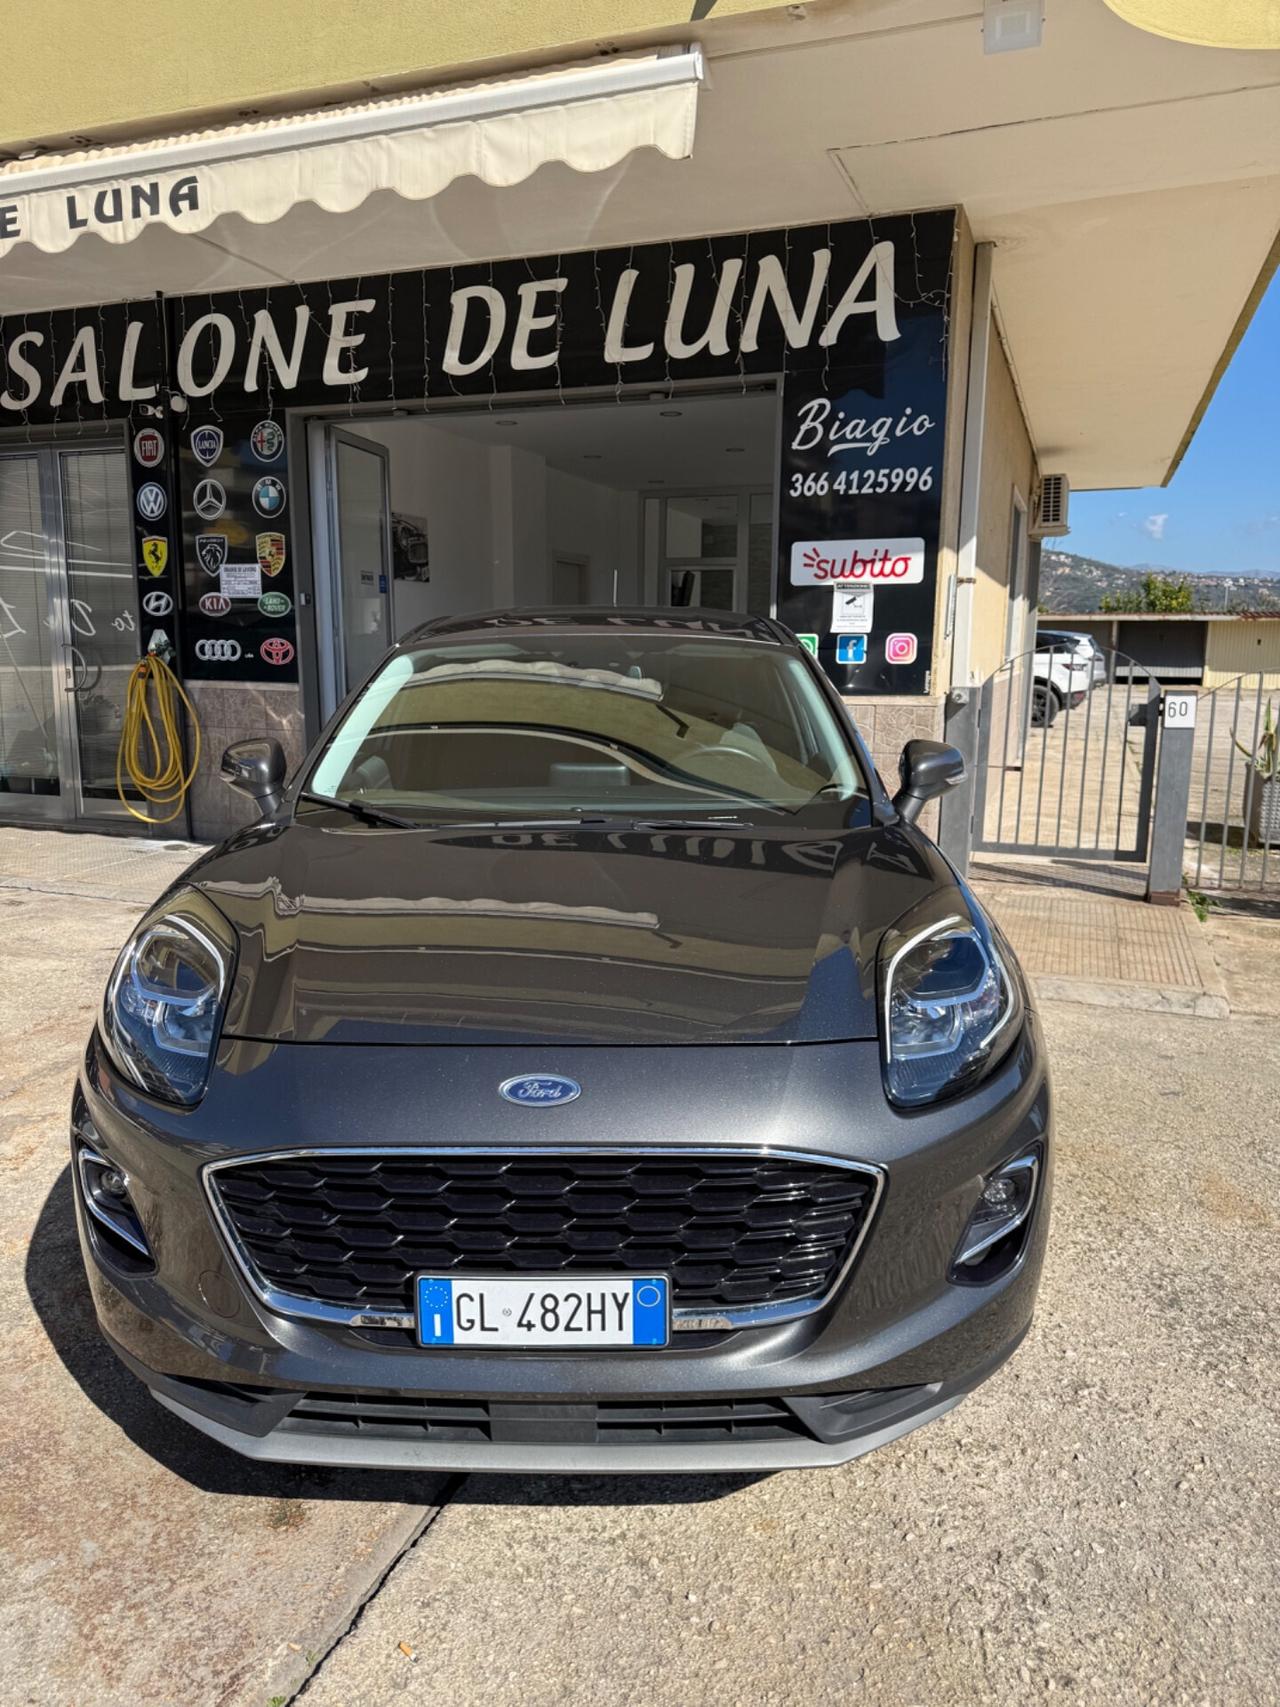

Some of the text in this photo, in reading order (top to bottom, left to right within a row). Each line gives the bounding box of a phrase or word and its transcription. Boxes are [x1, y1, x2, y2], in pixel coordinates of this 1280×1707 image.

[66, 176, 199, 229] LUNA
[0, 240, 901, 410] SALONE DE LUNA
[791, 397, 935, 457] Biagio
[141, 440, 158, 456] FIAT
[789, 466, 934, 498] 366 4125996
[813, 548, 912, 580] subito
[204, 597, 226, 610] KIA
[1168, 701, 1188, 718] 60
[517, 1080, 562, 1098] Ford
[455, 1292, 631, 1332] GL 482HY
